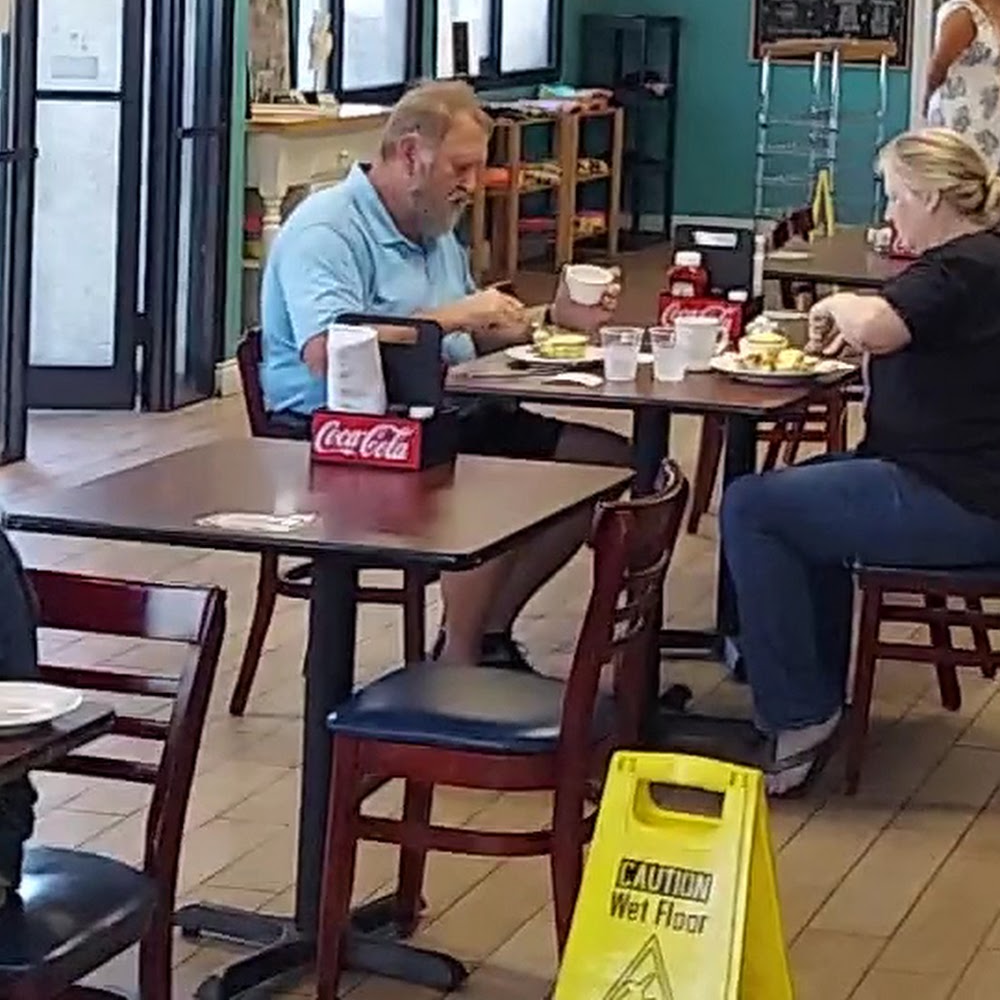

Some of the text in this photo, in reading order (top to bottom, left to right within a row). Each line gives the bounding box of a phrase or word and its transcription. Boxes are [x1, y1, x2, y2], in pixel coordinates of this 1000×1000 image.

[617, 860, 711, 902] CAUTION
[610, 891, 708, 933] Wet Floor
